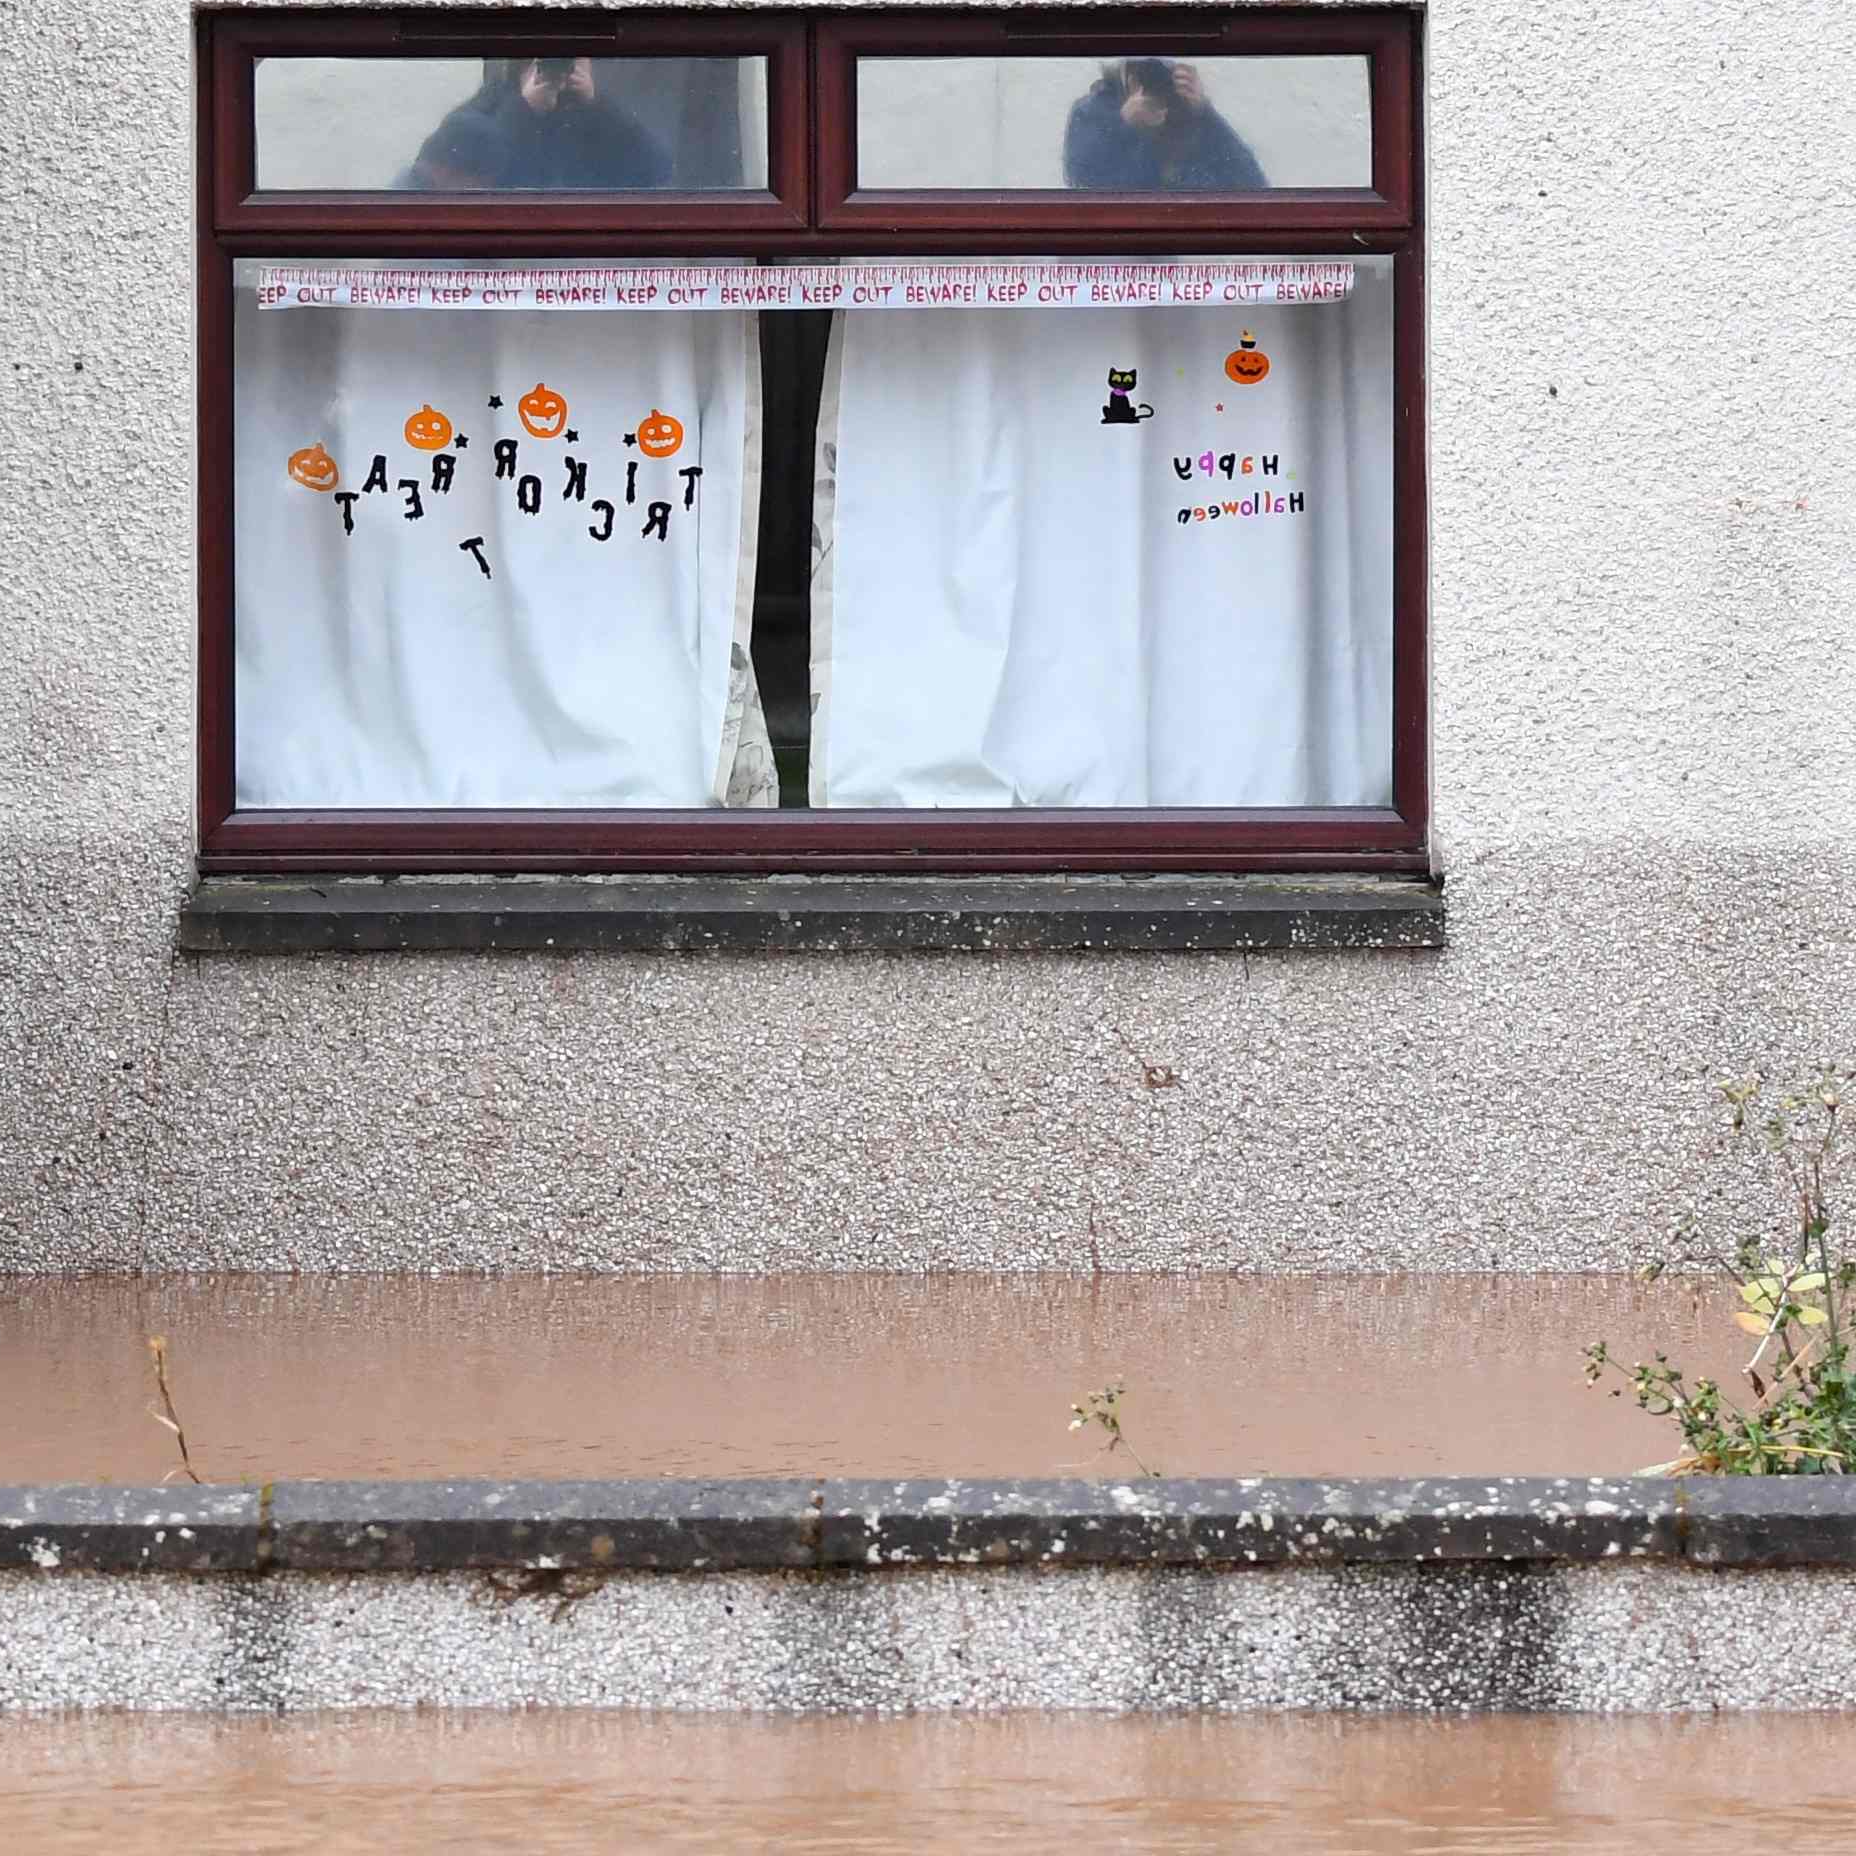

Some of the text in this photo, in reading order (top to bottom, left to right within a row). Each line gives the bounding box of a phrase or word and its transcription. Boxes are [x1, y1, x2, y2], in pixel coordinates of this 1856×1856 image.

[259, 285, 286, 303] EEP
[296, 287, 336, 303] OUT
[350, 286, 420, 304] BEWARE!
[431, 286, 472, 304] KEEP
[482, 289, 522, 305] OUT
[535, 287, 607, 305] BEWARE!
[617, 284, 657, 304] KEEP
[667, 288, 708, 304] OUT
[720, 286, 791, 304] BEWARE!
[802, 284, 842, 303] KEEP
[853, 286, 892, 303] OUT
[906, 285, 976, 303] BEWARE!
[987, 282, 1027, 302] KEEP
[1038, 285, 1078, 302] OUT
[1091, 283, 1161, 302] BEWARE!
[1172, 281, 1212, 301] KEEP
[1223, 284, 1263, 301] OUT
